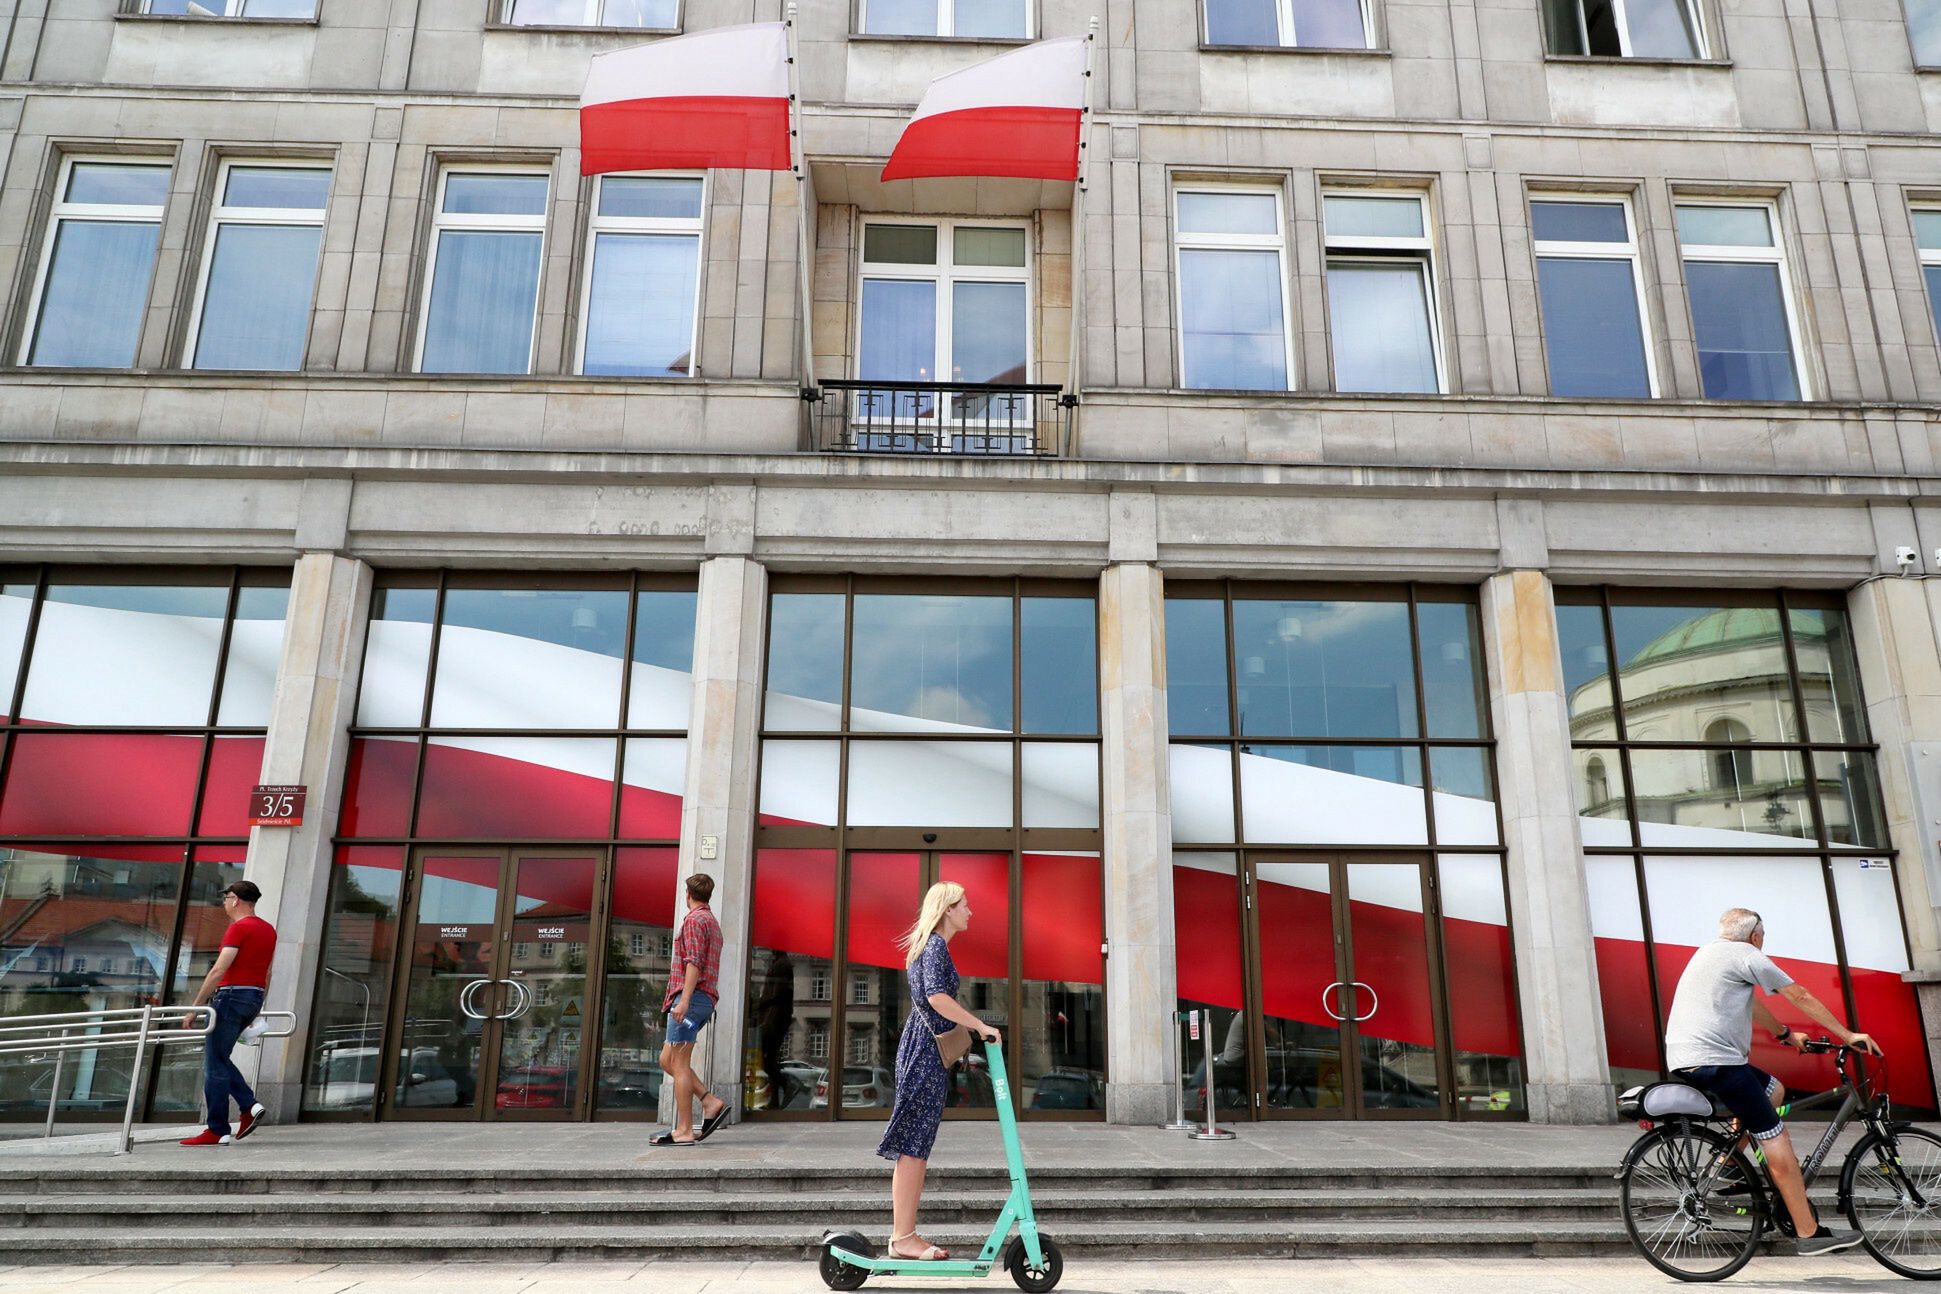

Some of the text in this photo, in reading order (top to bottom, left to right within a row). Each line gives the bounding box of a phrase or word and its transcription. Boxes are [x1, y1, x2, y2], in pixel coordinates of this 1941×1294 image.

[260, 793, 294, 817] 3/5
[538, 926, 565, 934] WEJŚCIE
[995, 1078, 1008, 1101] Bolt
[1808, 1122, 1840, 1175] ROMET
